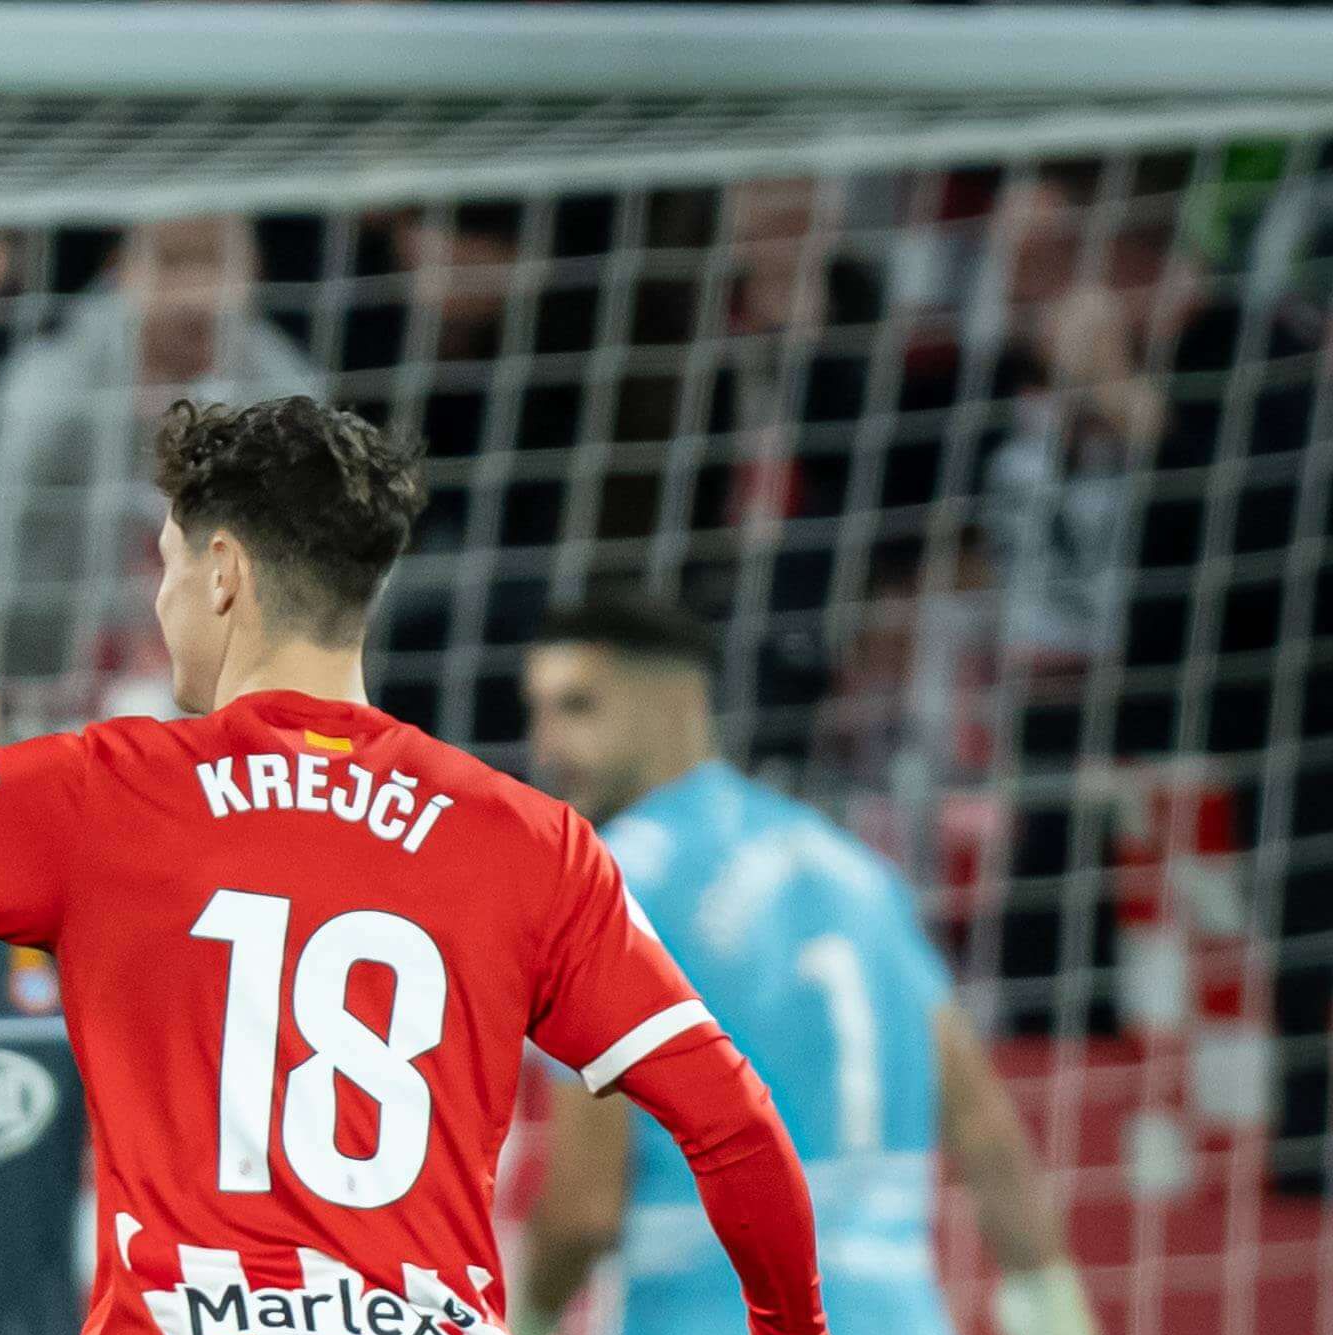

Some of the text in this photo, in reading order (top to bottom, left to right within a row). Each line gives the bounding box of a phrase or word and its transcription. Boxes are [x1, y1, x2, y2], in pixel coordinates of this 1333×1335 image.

[195, 752, 455, 855] KREJČÍ
[188, 887, 448, 1209] 18
[796, 933, 887, 1162] 1
